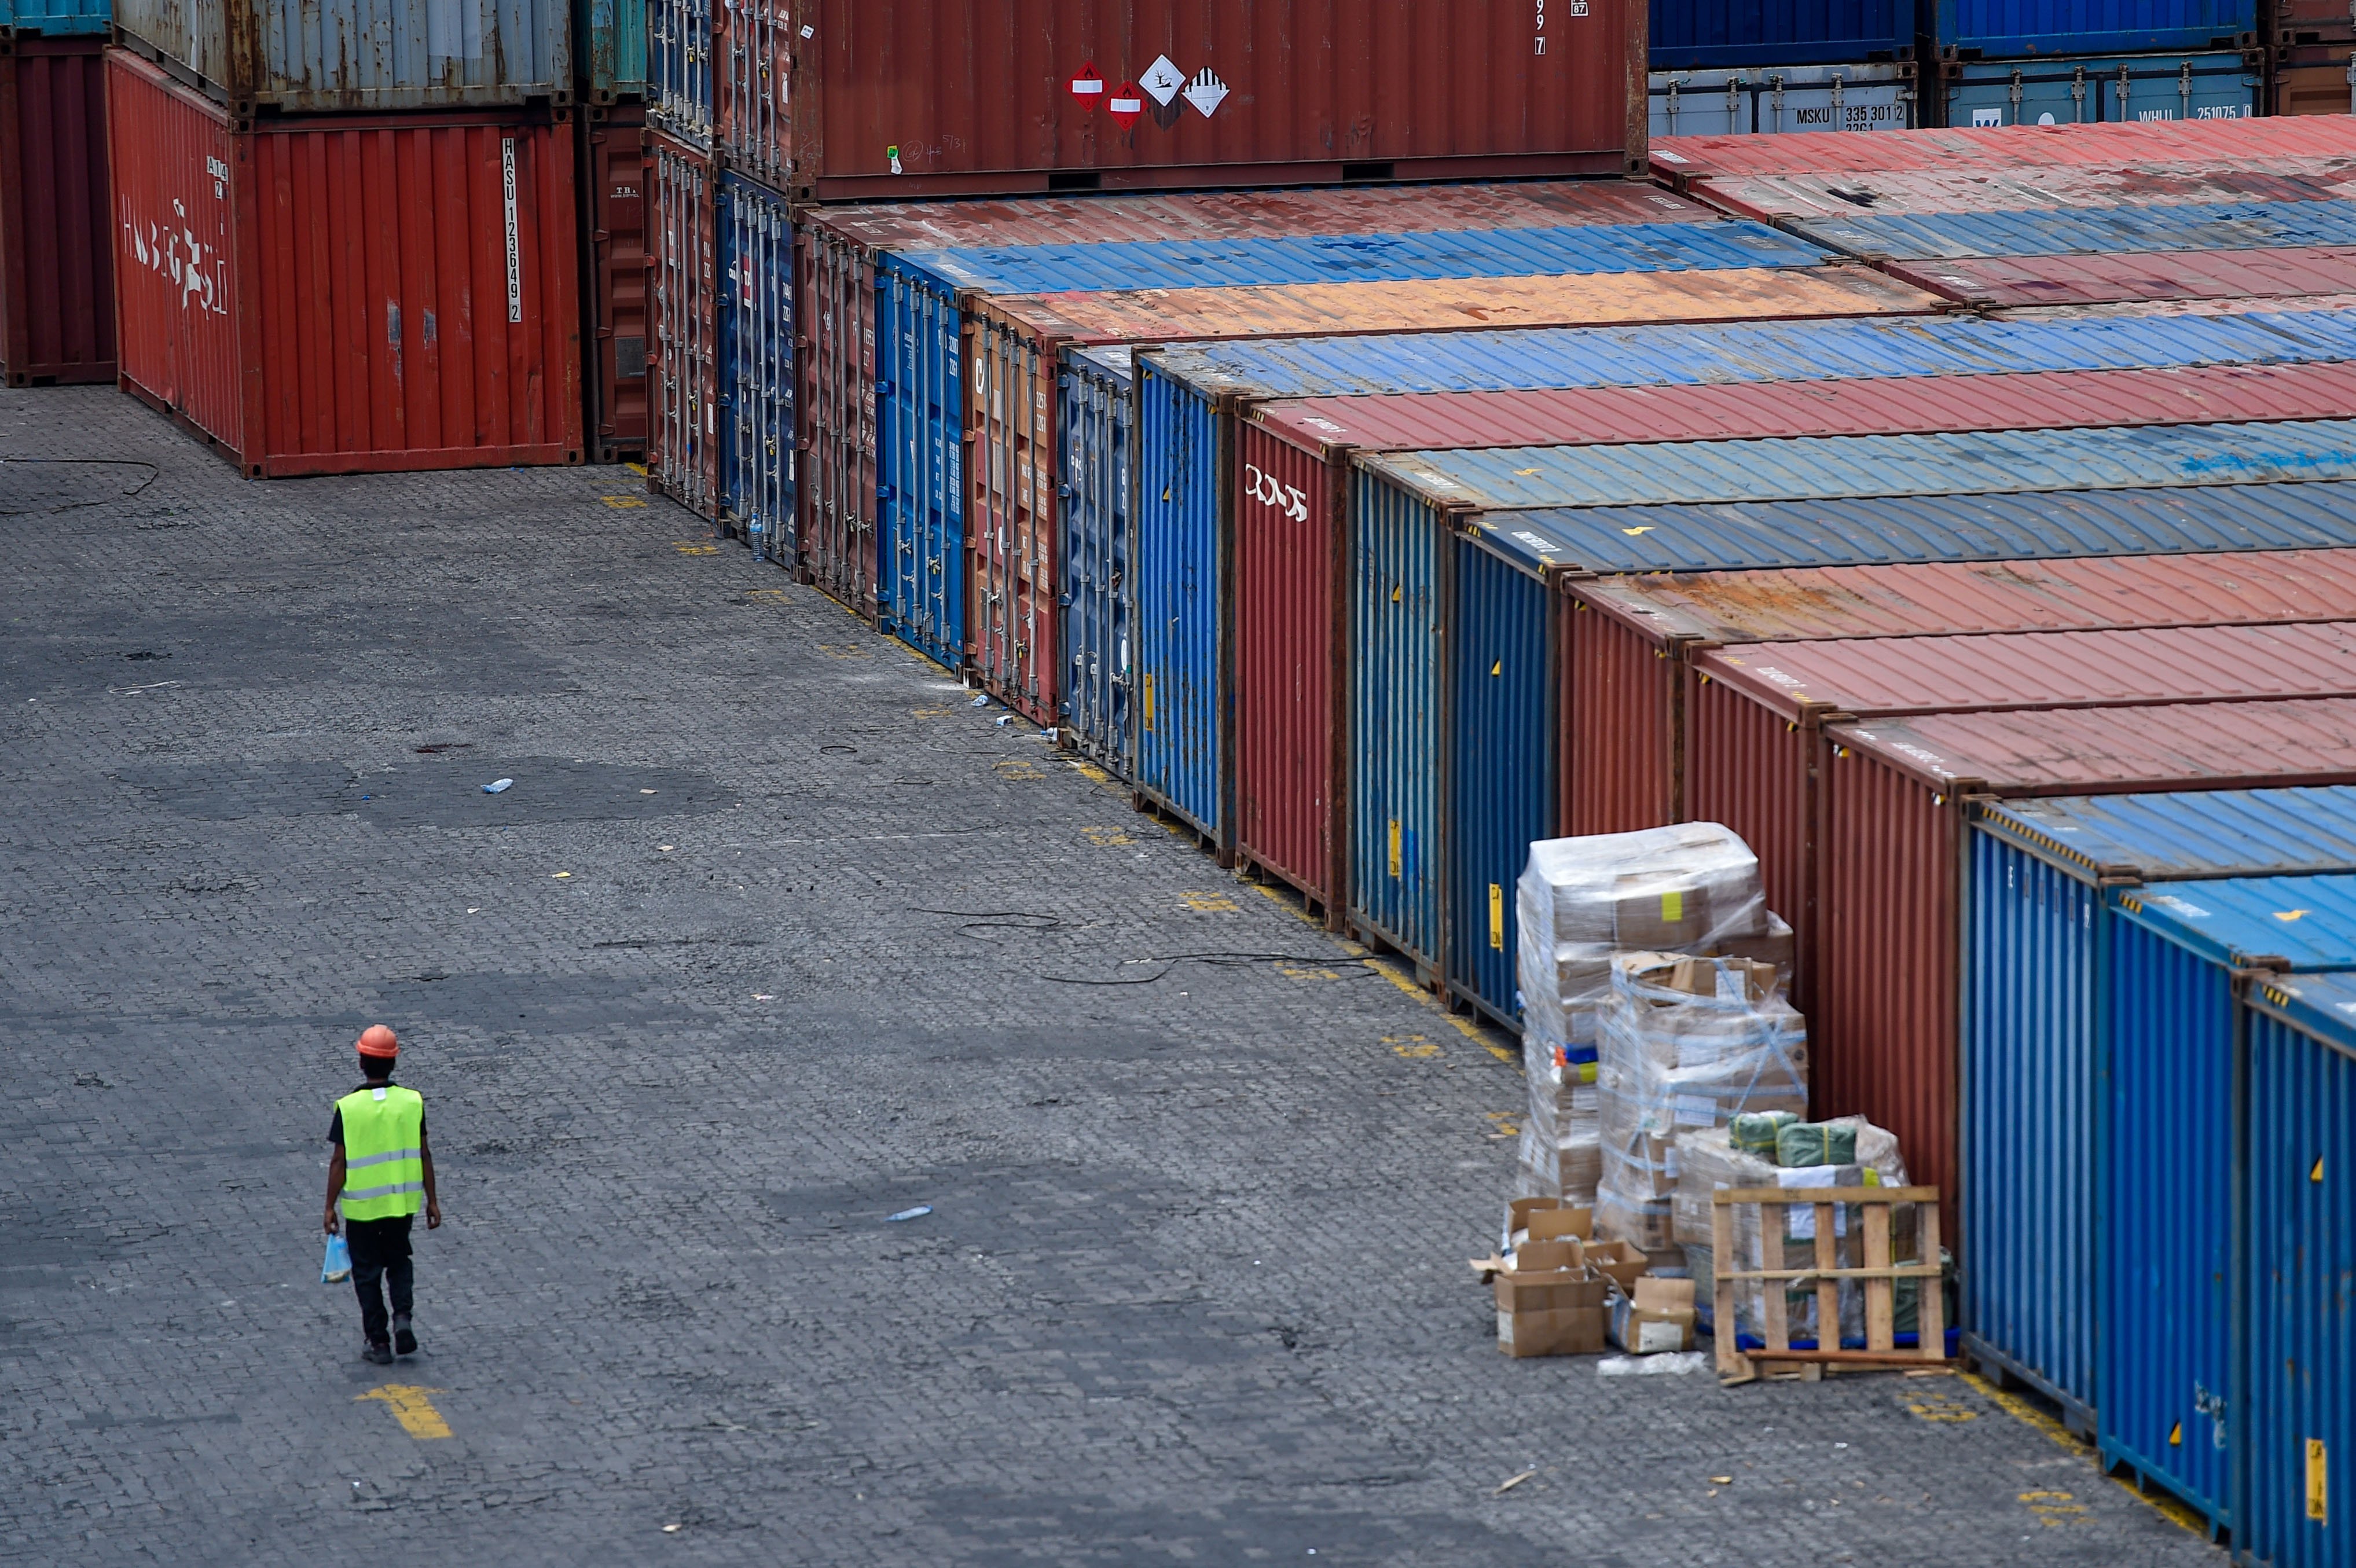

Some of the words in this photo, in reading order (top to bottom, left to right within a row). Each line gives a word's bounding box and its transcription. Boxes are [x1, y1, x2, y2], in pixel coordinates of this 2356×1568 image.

[1573, 5, 1585, 13] 87
[1536, 38, 1544, 54] 7
[1797, 108, 1830, 124] MSKU
[1846, 107, 1865, 122] 335
[1871, 106, 1891, 120] 301
[1896, 106, 1903, 120] 2
[2197, 105, 2236, 120] 251075
[505, 139, 514, 200] HASU
[509, 206, 518, 298] 123649
[512, 305, 519, 320] 2
